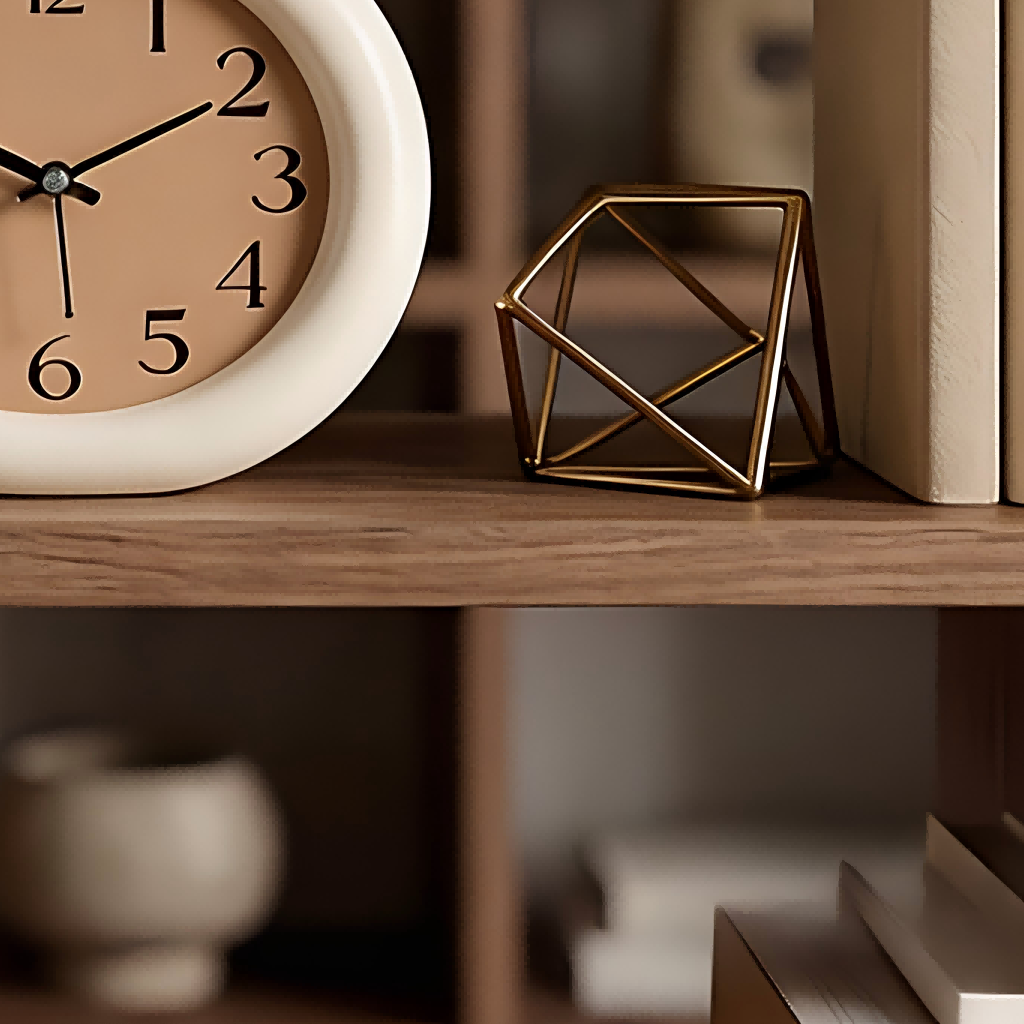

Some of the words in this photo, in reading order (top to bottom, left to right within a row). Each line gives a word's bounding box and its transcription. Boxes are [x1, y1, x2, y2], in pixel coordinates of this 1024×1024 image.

[216, 47, 270, 117] 2
[252, 145, 307, 213] 3
[215, 240, 268, 309] 4
[28, 334, 82, 401] 6
[137, 308, 190, 375] 5
